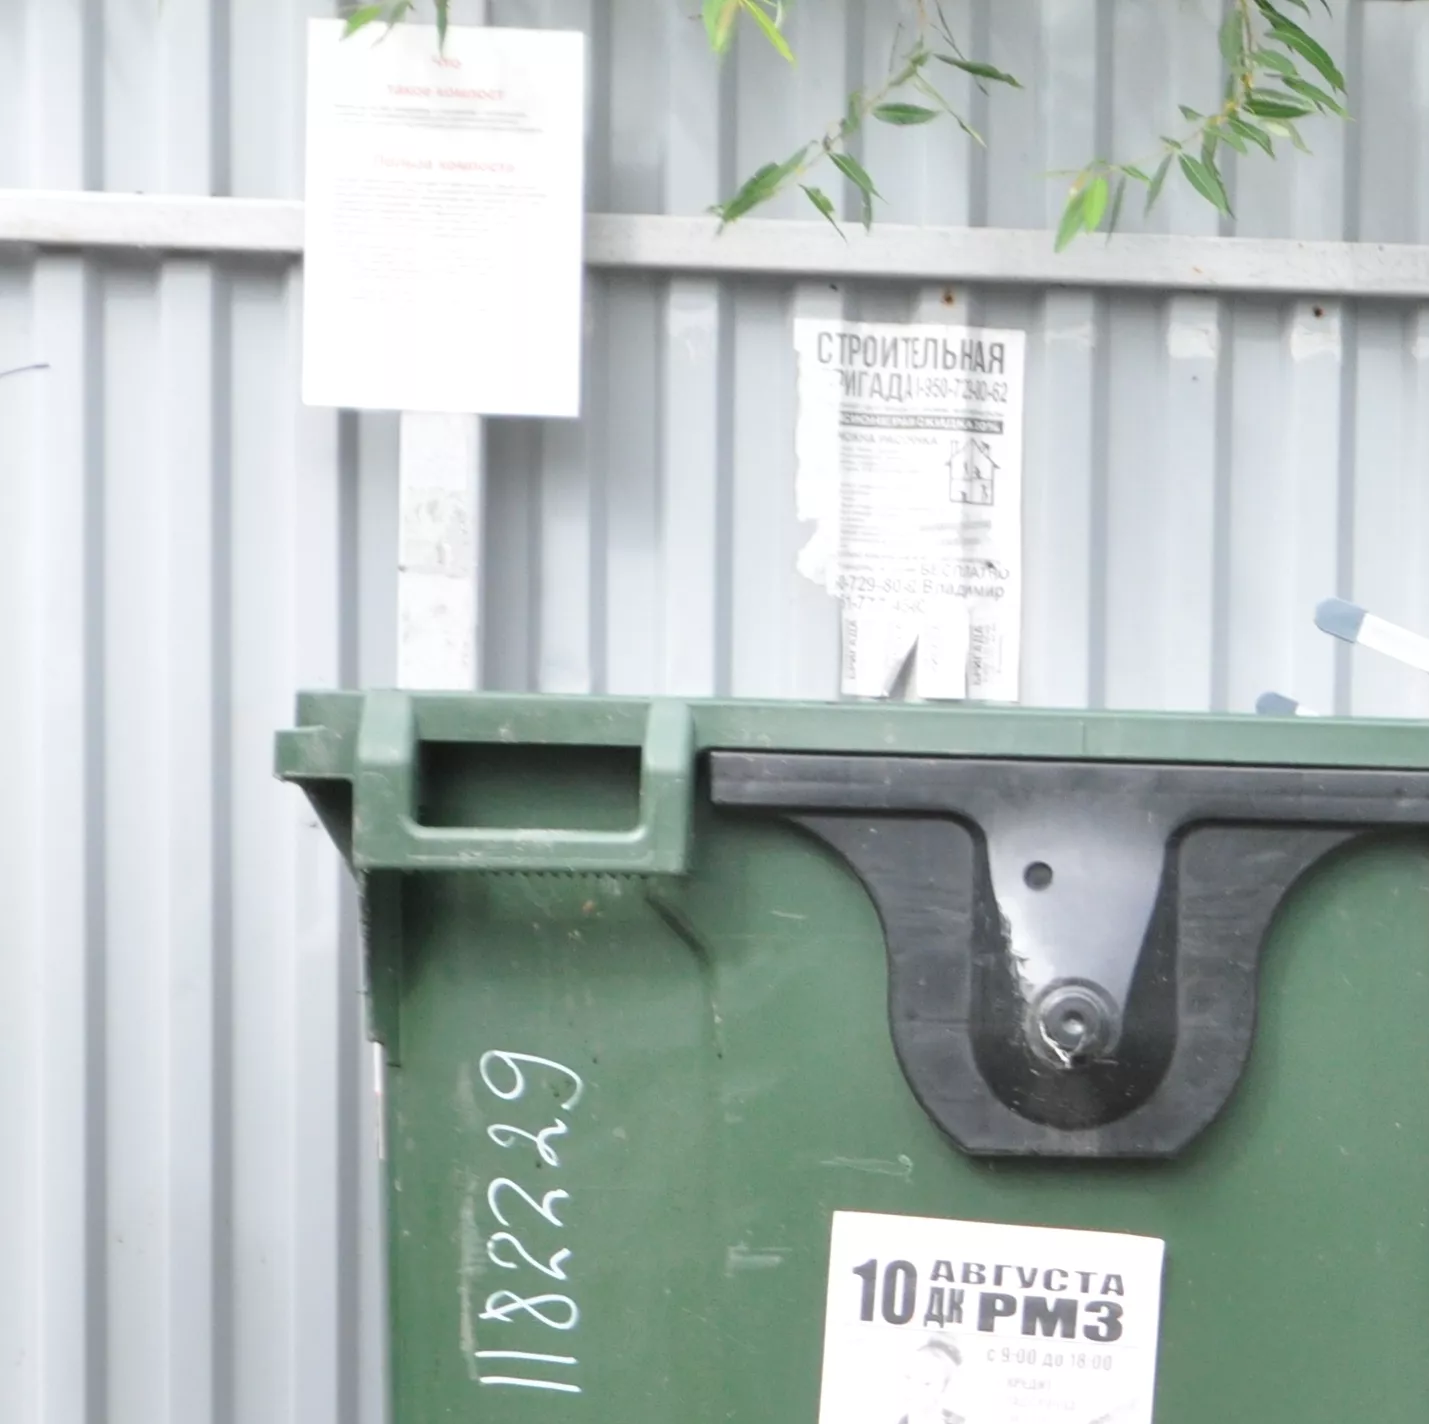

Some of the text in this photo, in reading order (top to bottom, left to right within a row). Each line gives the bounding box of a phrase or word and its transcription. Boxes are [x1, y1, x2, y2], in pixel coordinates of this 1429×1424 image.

[817, 331, 1006, 374] СТРОИТЕЛЬНАЯ
[474, 1049, 584, 1392] 1182229
[852, 1258, 1125, 1326] 10 АВГУСТА
[923, 1286, 1124, 1343] ДК РМЗ
[1041, 1352, 1065, 1368] до
